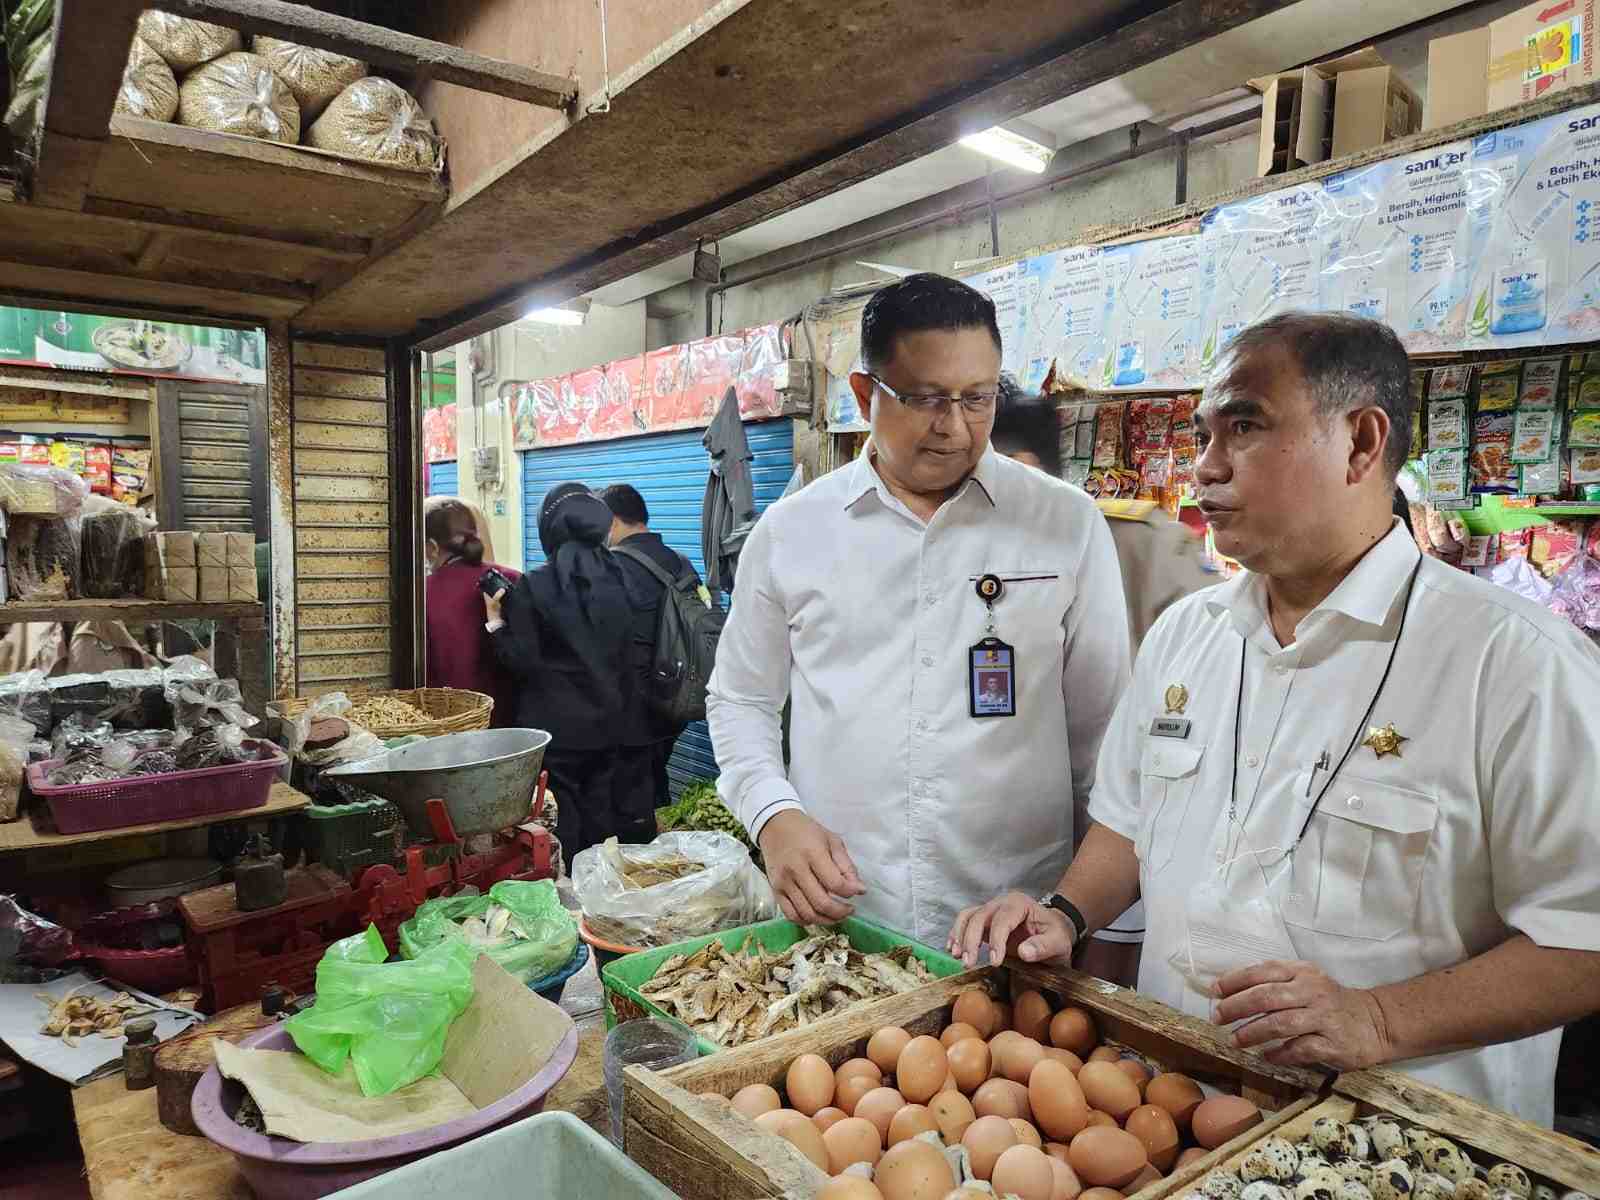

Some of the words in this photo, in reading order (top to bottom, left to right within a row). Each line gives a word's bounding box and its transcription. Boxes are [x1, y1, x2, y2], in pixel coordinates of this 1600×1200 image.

[1549, 159, 1590, 176] Bersih,
[1547, 174, 1580, 188] Lebih
[1388, 198, 1423, 213] Bersih,
[1424, 189, 1467, 204] Higienis
[1386, 211, 1414, 224] Lebih
[1416, 200, 1467, 217] Ekonomis
